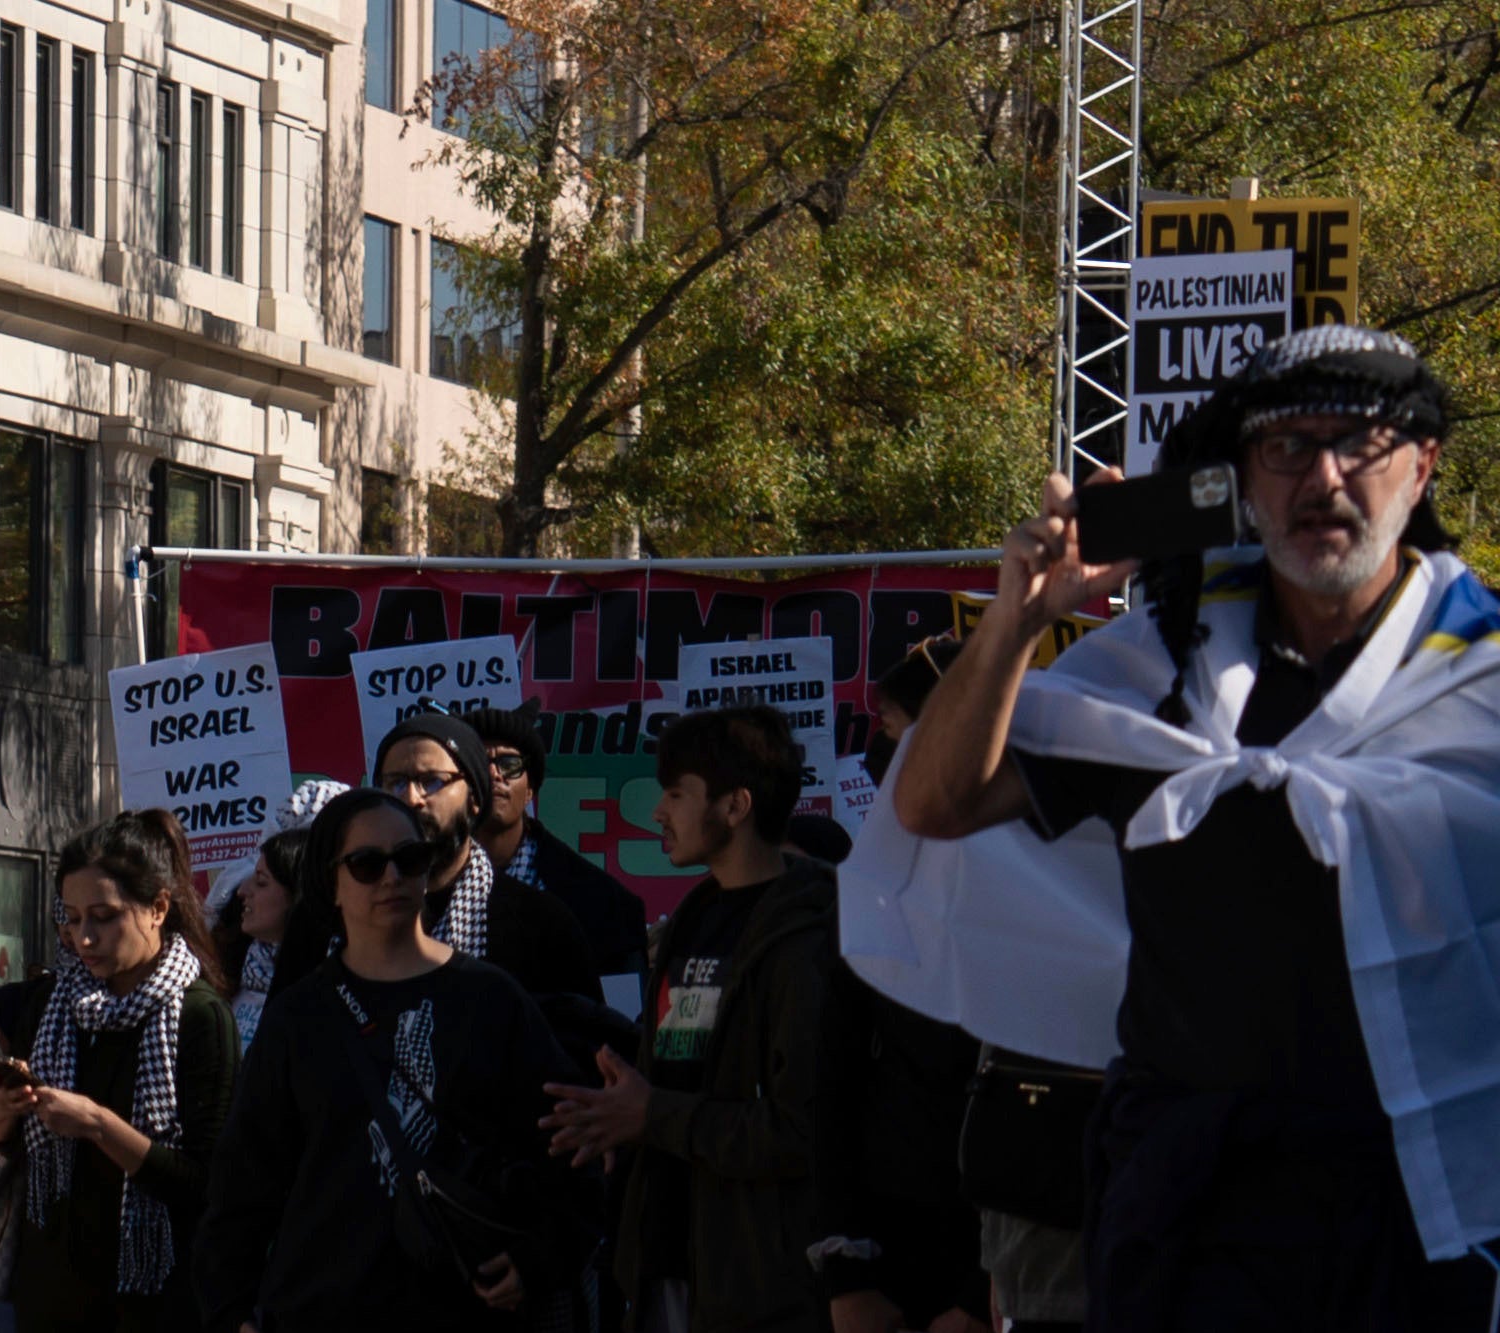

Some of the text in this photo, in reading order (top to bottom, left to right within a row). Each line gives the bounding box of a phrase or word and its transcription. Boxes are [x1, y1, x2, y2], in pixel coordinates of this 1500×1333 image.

[1137, 274, 1285, 309] PALESTINIAN
[1159, 323, 1264, 381] LIVES
[368, 656, 512, 698] STOP U.S.
[710, 652, 797, 677] ISRAEL
[124, 664, 273, 713] STOP U.S.
[686, 680, 825, 708] APARTHEID
[149, 706, 255, 747] ISRAEL
[165, 760, 240, 797] WAR
[182, 797, 267, 833] RIMES
[336, 984, 369, 1025] SONY
